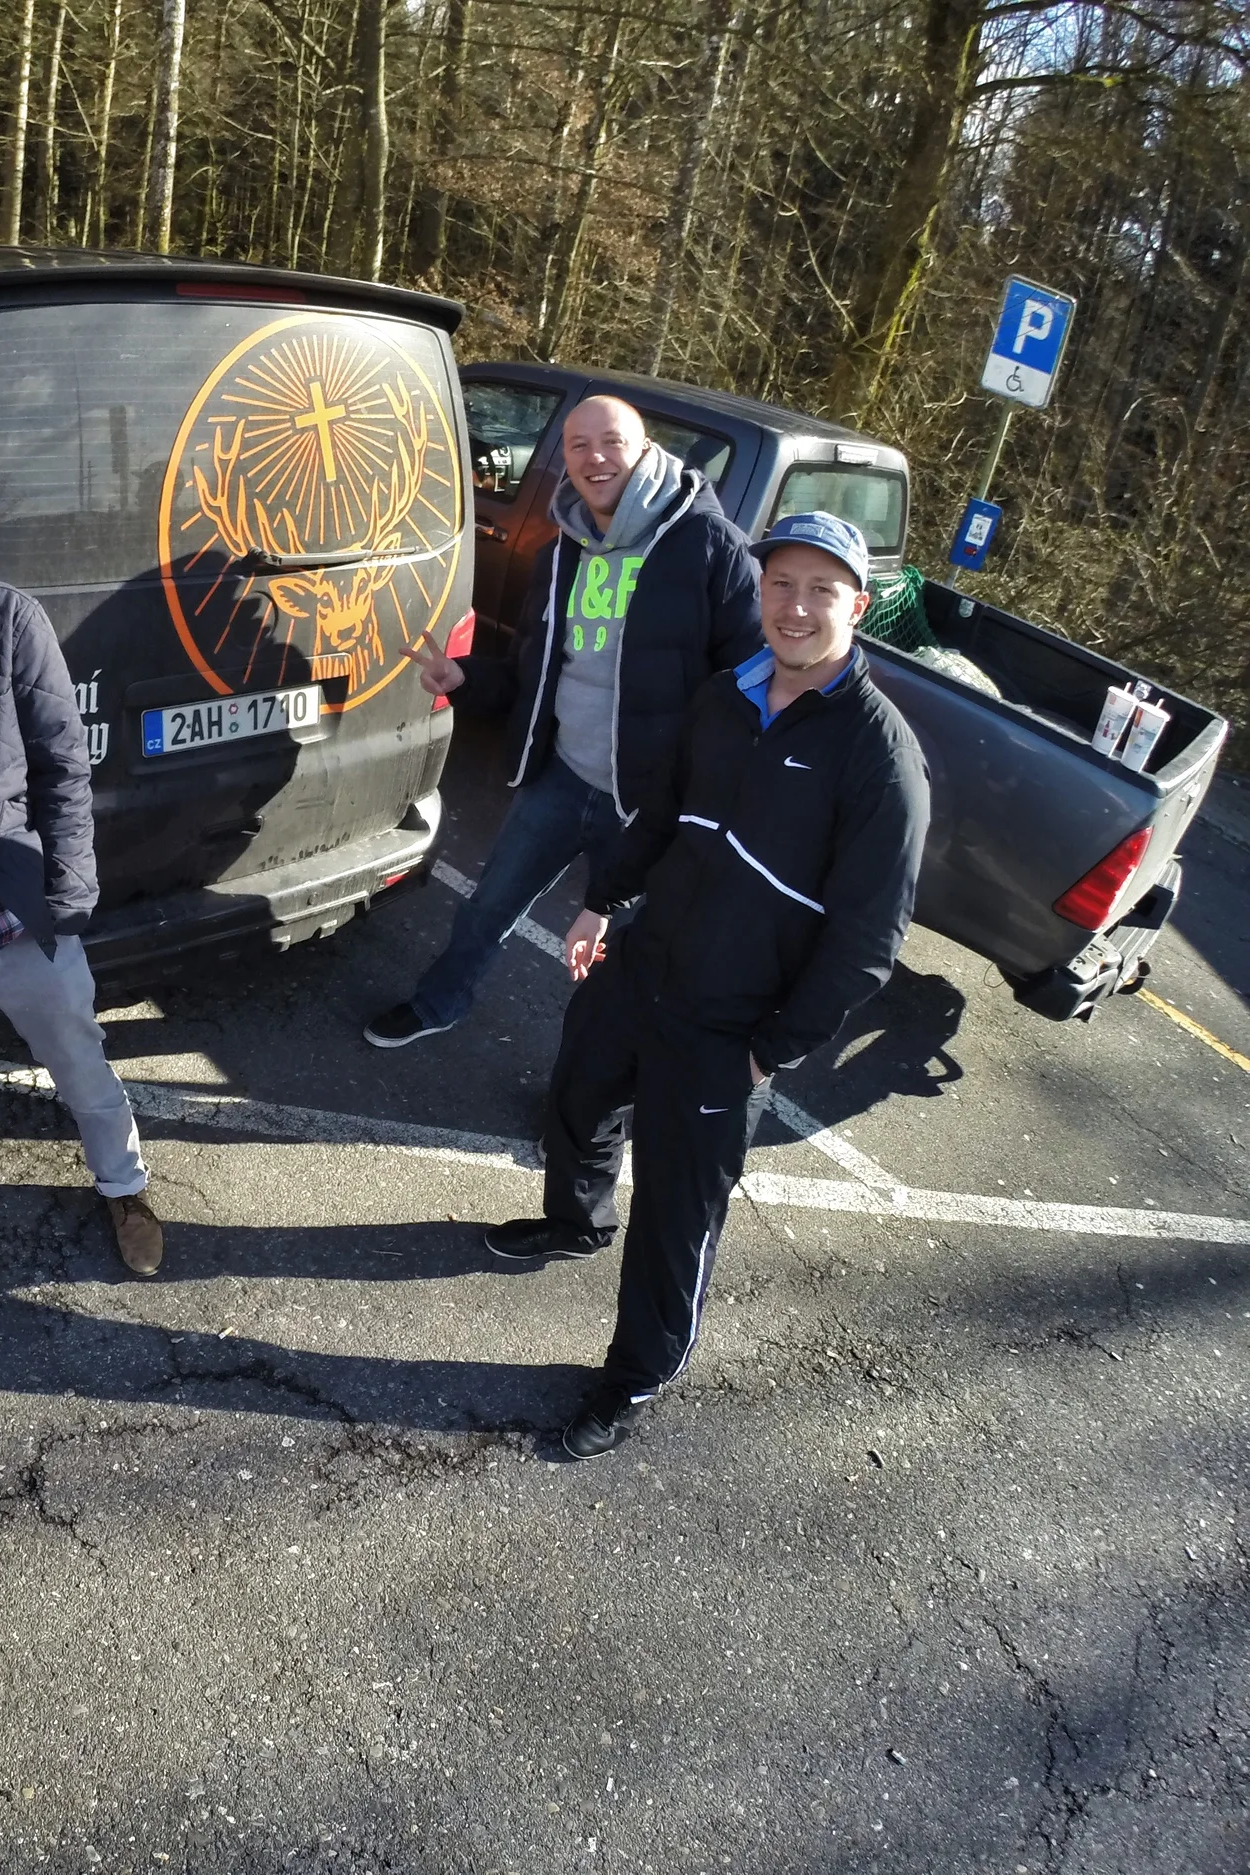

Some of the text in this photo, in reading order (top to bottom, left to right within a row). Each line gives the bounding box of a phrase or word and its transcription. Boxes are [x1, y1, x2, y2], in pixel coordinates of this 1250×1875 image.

[1012, 299, 1054, 355] P
[566, 556, 644, 619] &F
[247, 691, 307, 731] 1710
[146, 738, 162, 750] CZ
